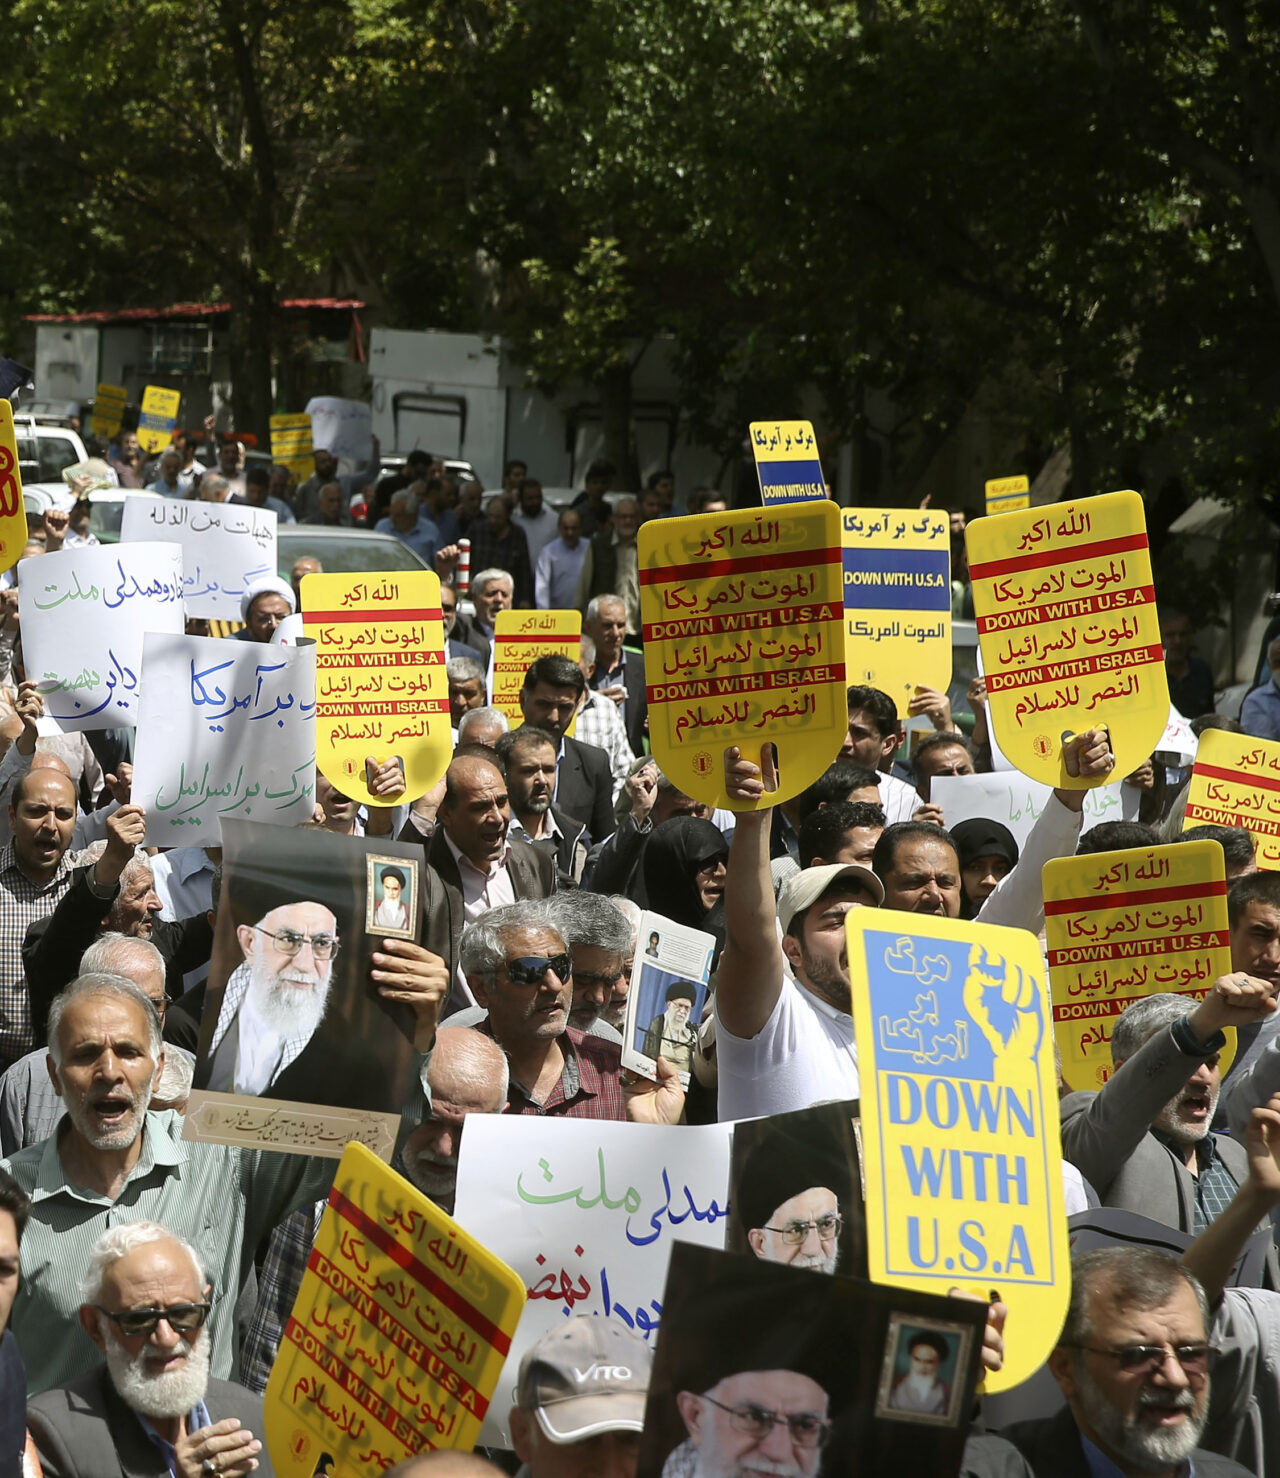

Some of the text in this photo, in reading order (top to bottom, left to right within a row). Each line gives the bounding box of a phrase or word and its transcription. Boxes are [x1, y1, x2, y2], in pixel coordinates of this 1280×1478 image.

[763, 485, 787, 499] DOWN
[786, 484, 805, 497] WITH
[190, 511, 221, 532] من
[892, 521, 906, 539] بر
[912, 517, 945, 540] مرگ
[33, 570, 100, 610] ملت
[750, 572, 815, 604] الموت
[844, 571, 945, 588] DOWN WITH U.S.A
[1070, 559, 1127, 590] الموت
[651, 604, 833, 640] DOWN WITH U.S.A
[984, 589, 1146, 632] DOWN WITH U.S.A
[380, 626, 424, 648] الموت
[904, 622, 945, 643] الموت
[1082, 616, 1139, 647] الموت
[359, 654, 398, 667] WITH
[400, 652, 439, 665] U.S.A
[759, 632, 822, 664] الموت
[496, 663, 525, 672] DOWN
[991, 648, 1154, 690] DOWN WITH ISRAEL
[387, 673, 432, 695] الموت
[653, 666, 836, 701] DOWN WITH ISRAEL
[357, 702, 395, 716] WITH
[396, 700, 443, 714] ISRAEL
[494, 695, 520, 704] DOWN
[1191, 806, 1278, 835] DOWN WITH
[1145, 904, 1203, 933] الموت
[884, 936, 952, 985] مرگ
[1056, 932, 1221, 965] DOWN WITH U.S.A
[1154, 958, 1211, 986] الموت
[908, 990, 939, 1026] بر
[1059, 1001, 1111, 1019] DOWN
[886, 1073, 1036, 1139] DOWN
[517, 1146, 642, 1214] ملت
[900, 1144, 1030, 1206] WITH
[906, 1215, 1035, 1276] U.S.A
[315, 1253, 477, 1413] DOWN WITH U.S.A
[415, 1303, 478, 1366] الموت
[290, 1323, 389, 1422] DOWN WITH
[573, 1362, 633, 1384] VITO
[395, 1376, 458, 1437] الموت
